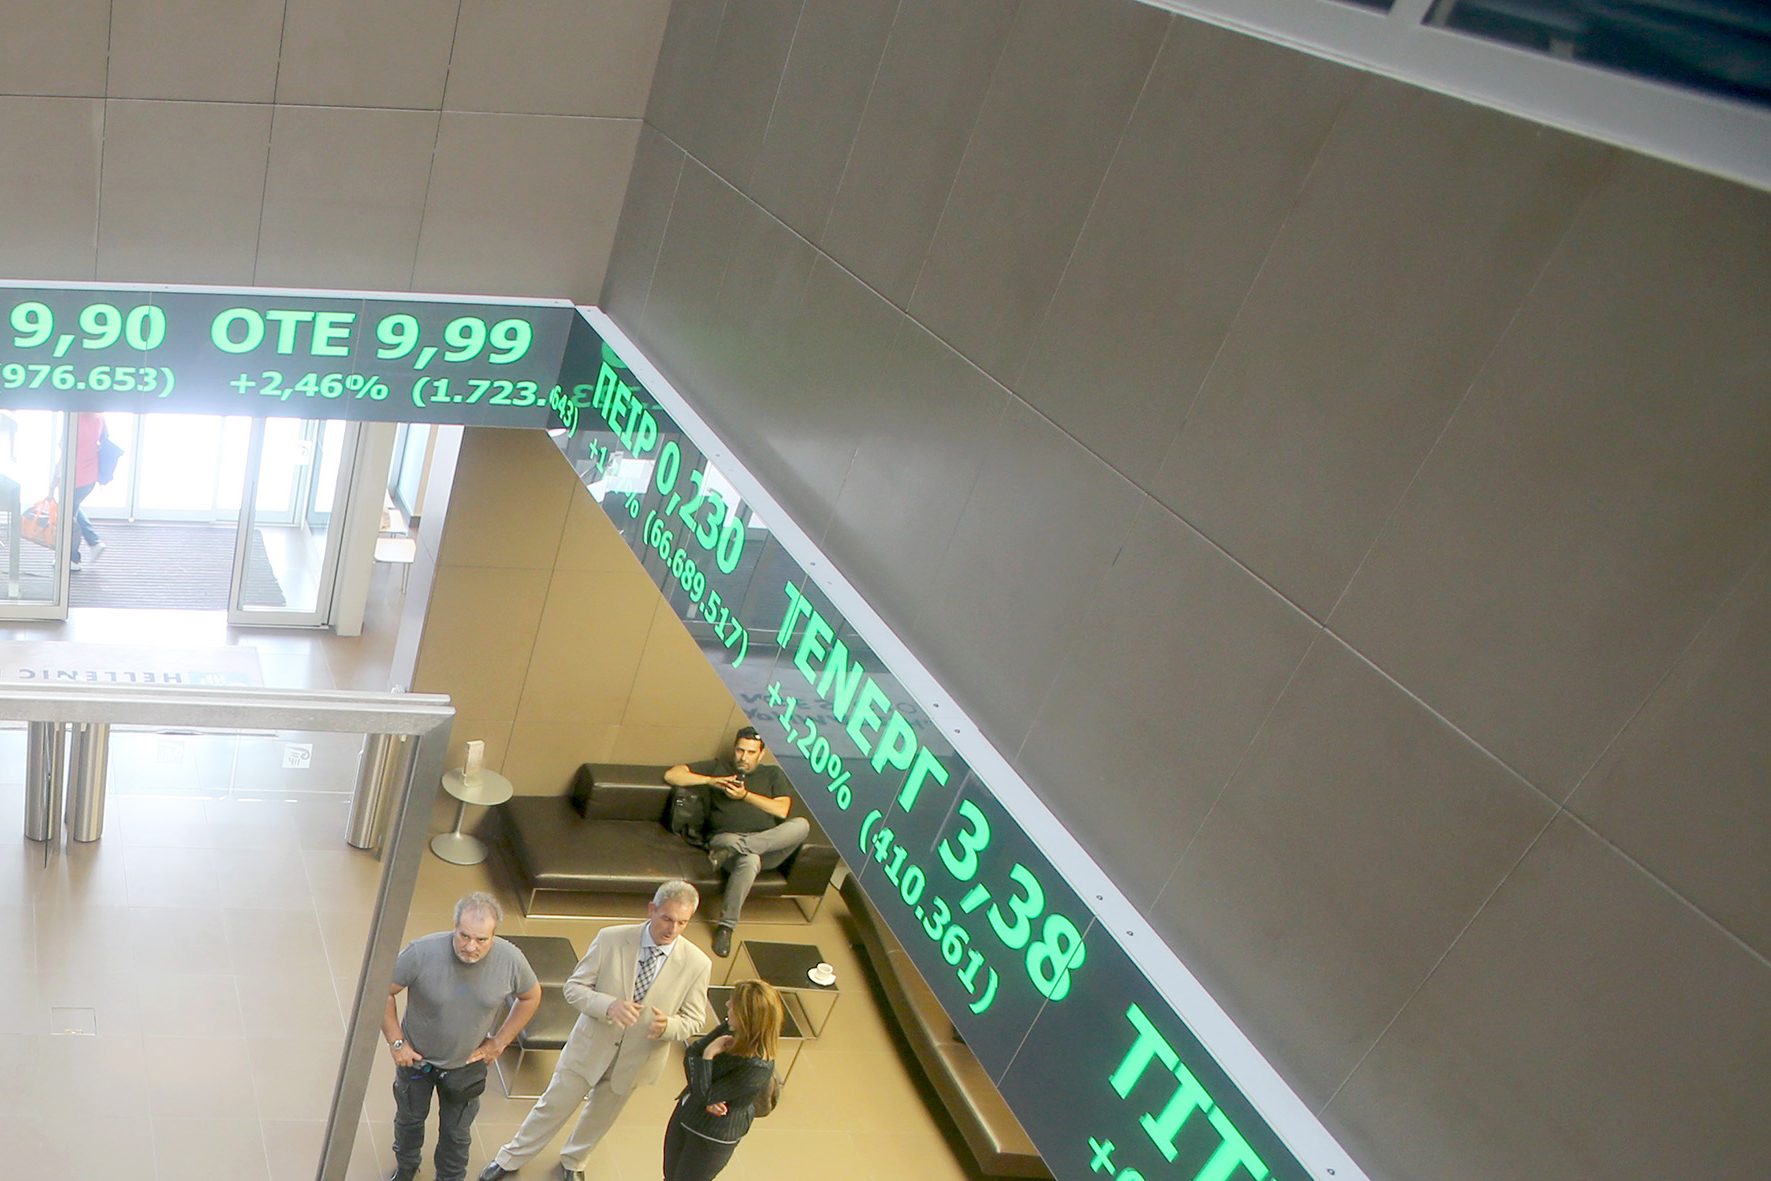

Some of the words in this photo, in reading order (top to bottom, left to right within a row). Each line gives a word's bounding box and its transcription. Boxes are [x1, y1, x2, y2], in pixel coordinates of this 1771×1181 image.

[9, 301, 168, 359] 9,90
[209, 306, 357, 358] ΟΤΕ
[374, 312, 534, 369] 9,99
[228, 370, 390, 401] +2,46%
[592, 360, 659, 458] ΠΕΙΡ
[655, 440, 746, 574] 0,230
[642, 509, 750, 669] (66.689.517)
[18, 667, 183, 684] HELLENIC
[775, 580, 950, 813] ΤΕΝΕΡΓ
[937, 798, 1088, 1002] 3,38
[767, 681, 854, 811] +1,20%
[858, 809, 1000, 1015] (410.361)
